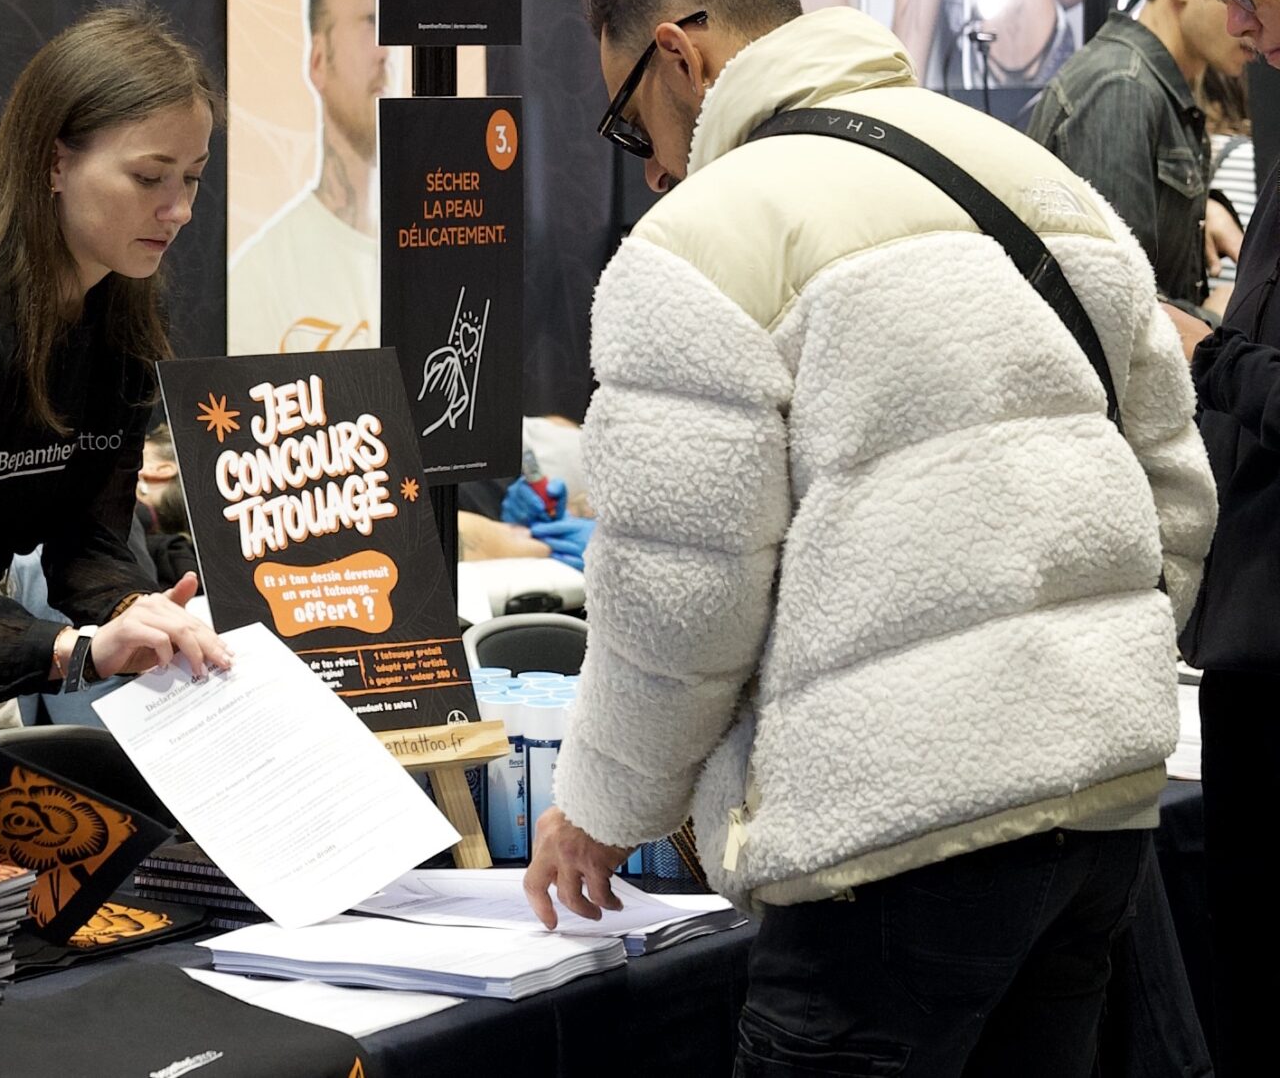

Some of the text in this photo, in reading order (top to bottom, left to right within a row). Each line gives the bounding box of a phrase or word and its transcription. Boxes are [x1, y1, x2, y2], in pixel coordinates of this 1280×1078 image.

[494, 124, 512, 154] 3.
[426, 166, 480, 192] SÉCHER
[423, 198, 484, 219] LA PEAU
[398, 222, 507, 248] DÉLICATEMENT.
[248, 374, 327, 447] JEU
[215, 413, 389, 503] CONCOURS
[223, 470, 399, 562] TATOUAGE
[263, 575, 276, 587] Et
[289, 573, 308, 586] ton
[310, 570, 342, 583] dessin
[343, 565, 390, 581] devenait
[282, 589, 297, 601] un
[299, 586, 322, 599] vrai
[293, 598, 359, 623] offert
[385, 732, 465, 755] entattoo.fr
